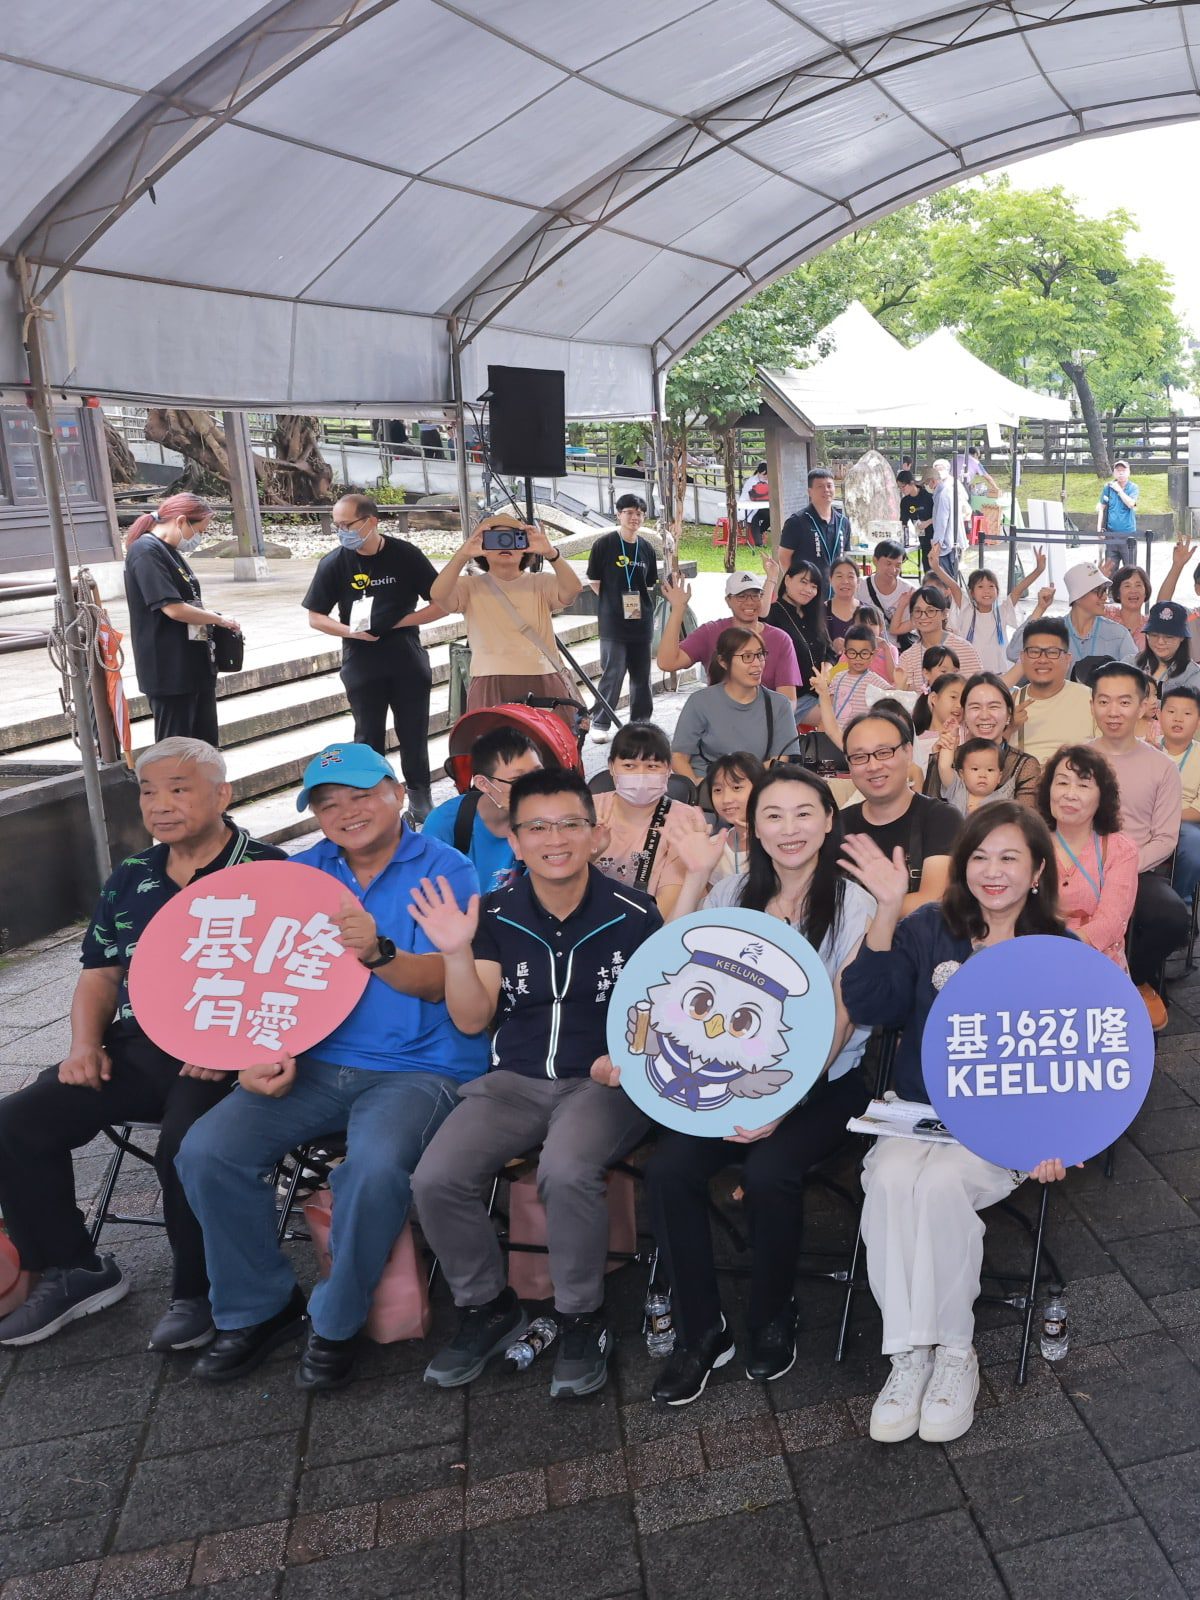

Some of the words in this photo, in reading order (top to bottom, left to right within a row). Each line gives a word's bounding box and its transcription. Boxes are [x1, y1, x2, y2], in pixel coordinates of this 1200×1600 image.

[180, 893, 346, 991] 基隆
[515, 961, 530, 995] 區長
[611, 950, 625, 985] 基隆
[716, 959, 766, 986] KEELUNG
[183, 971, 299, 1051] 有愛
[947, 1058, 1131, 1098] KEELUNG
